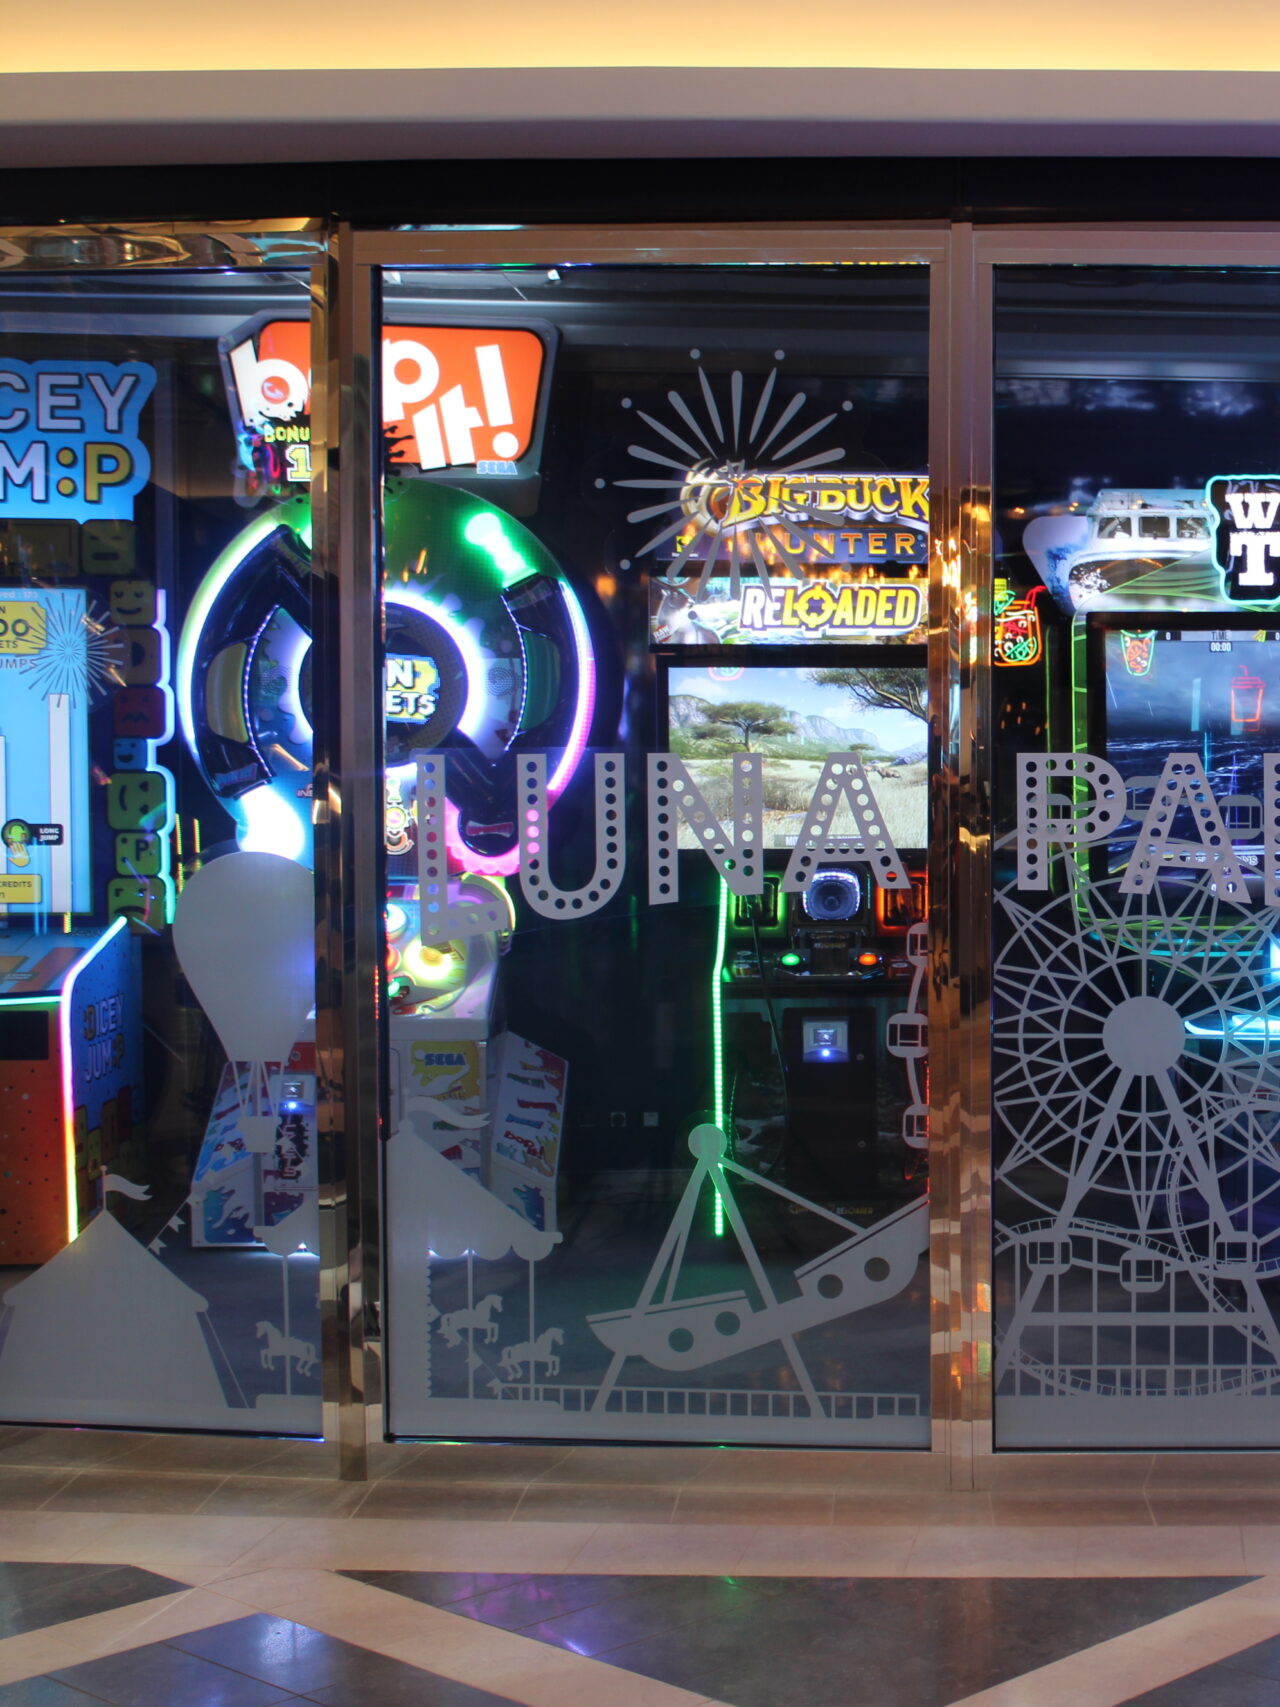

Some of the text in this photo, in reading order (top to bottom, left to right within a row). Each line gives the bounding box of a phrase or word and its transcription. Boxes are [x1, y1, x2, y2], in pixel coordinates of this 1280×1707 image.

[264, 425, 311, 442] BONU
[476, 460, 518, 475] SEGA
[722, 475, 930, 528] BIG BUCK
[755, 532, 917, 556] HUNTER
[740, 581, 918, 630] RELOADED
[1211, 631, 1230, 640] TIME
[1210, 641, 1232, 652] 00:00
[416, 752, 912, 945] LUNA
[424, 1053, 467, 1067] SEGA
